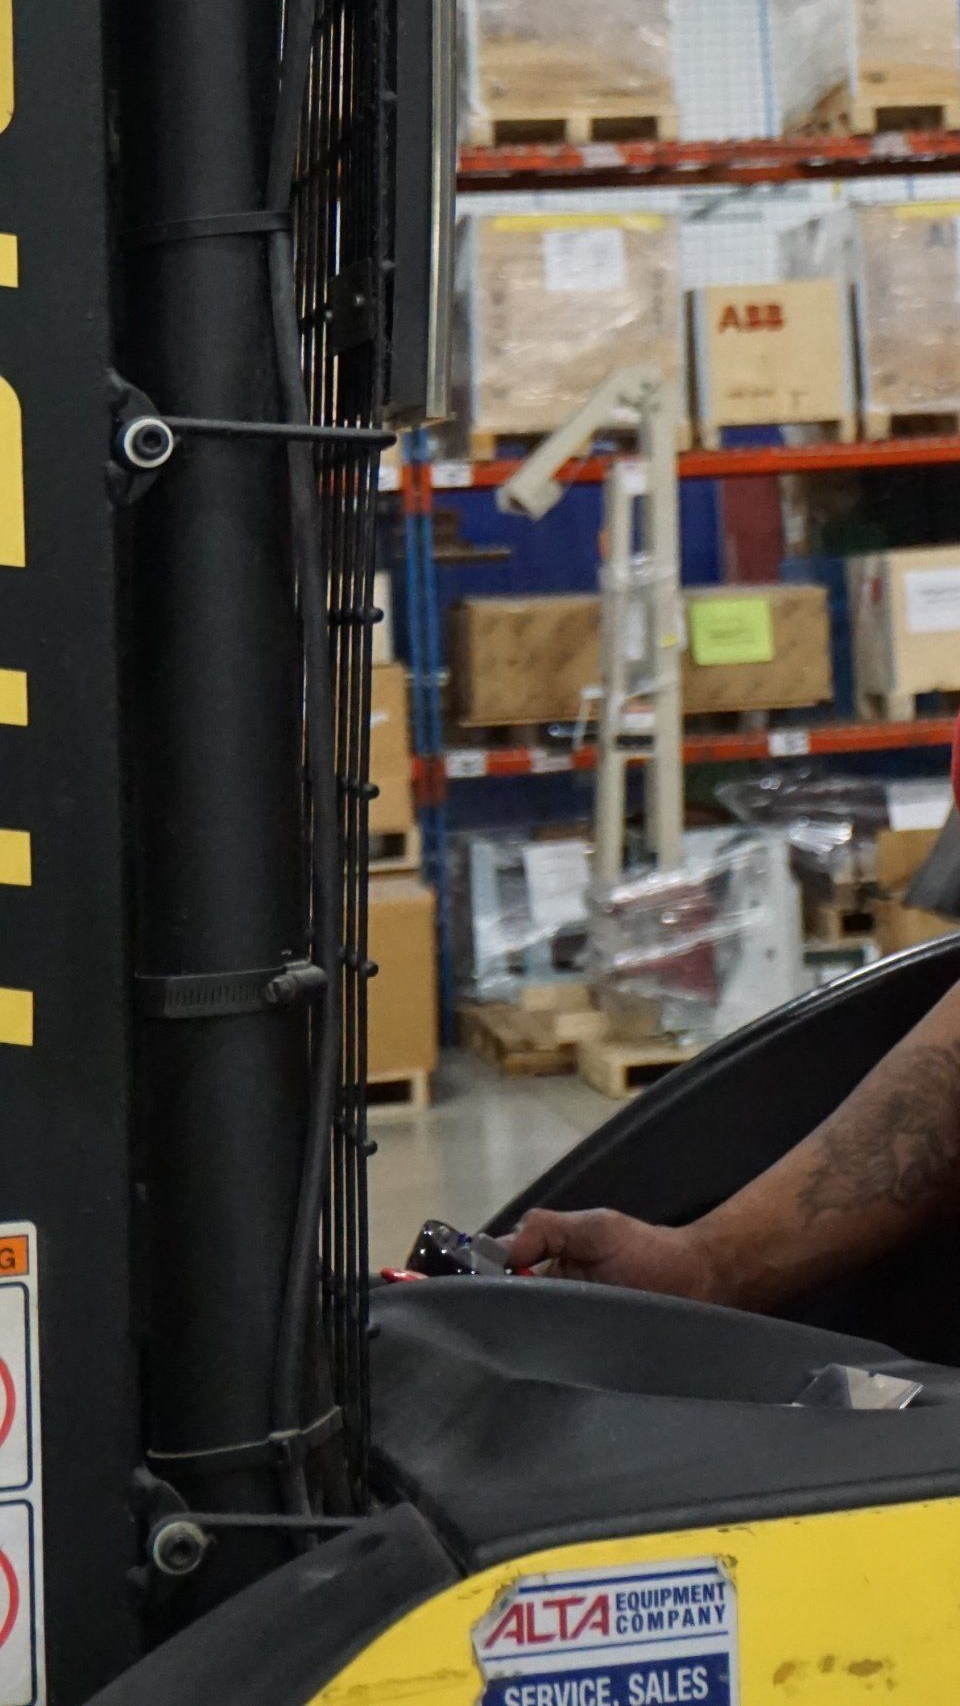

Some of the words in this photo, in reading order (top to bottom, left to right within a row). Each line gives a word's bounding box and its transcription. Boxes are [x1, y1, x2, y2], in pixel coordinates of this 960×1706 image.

[717, 304, 785, 334] ABB
[483, 1593, 611, 1650] ALTA
[614, 1580, 727, 1614] EQUIPMENT
[614, 1603, 727, 1636] COMPANY
[628, 1665, 710, 1706] SALES
